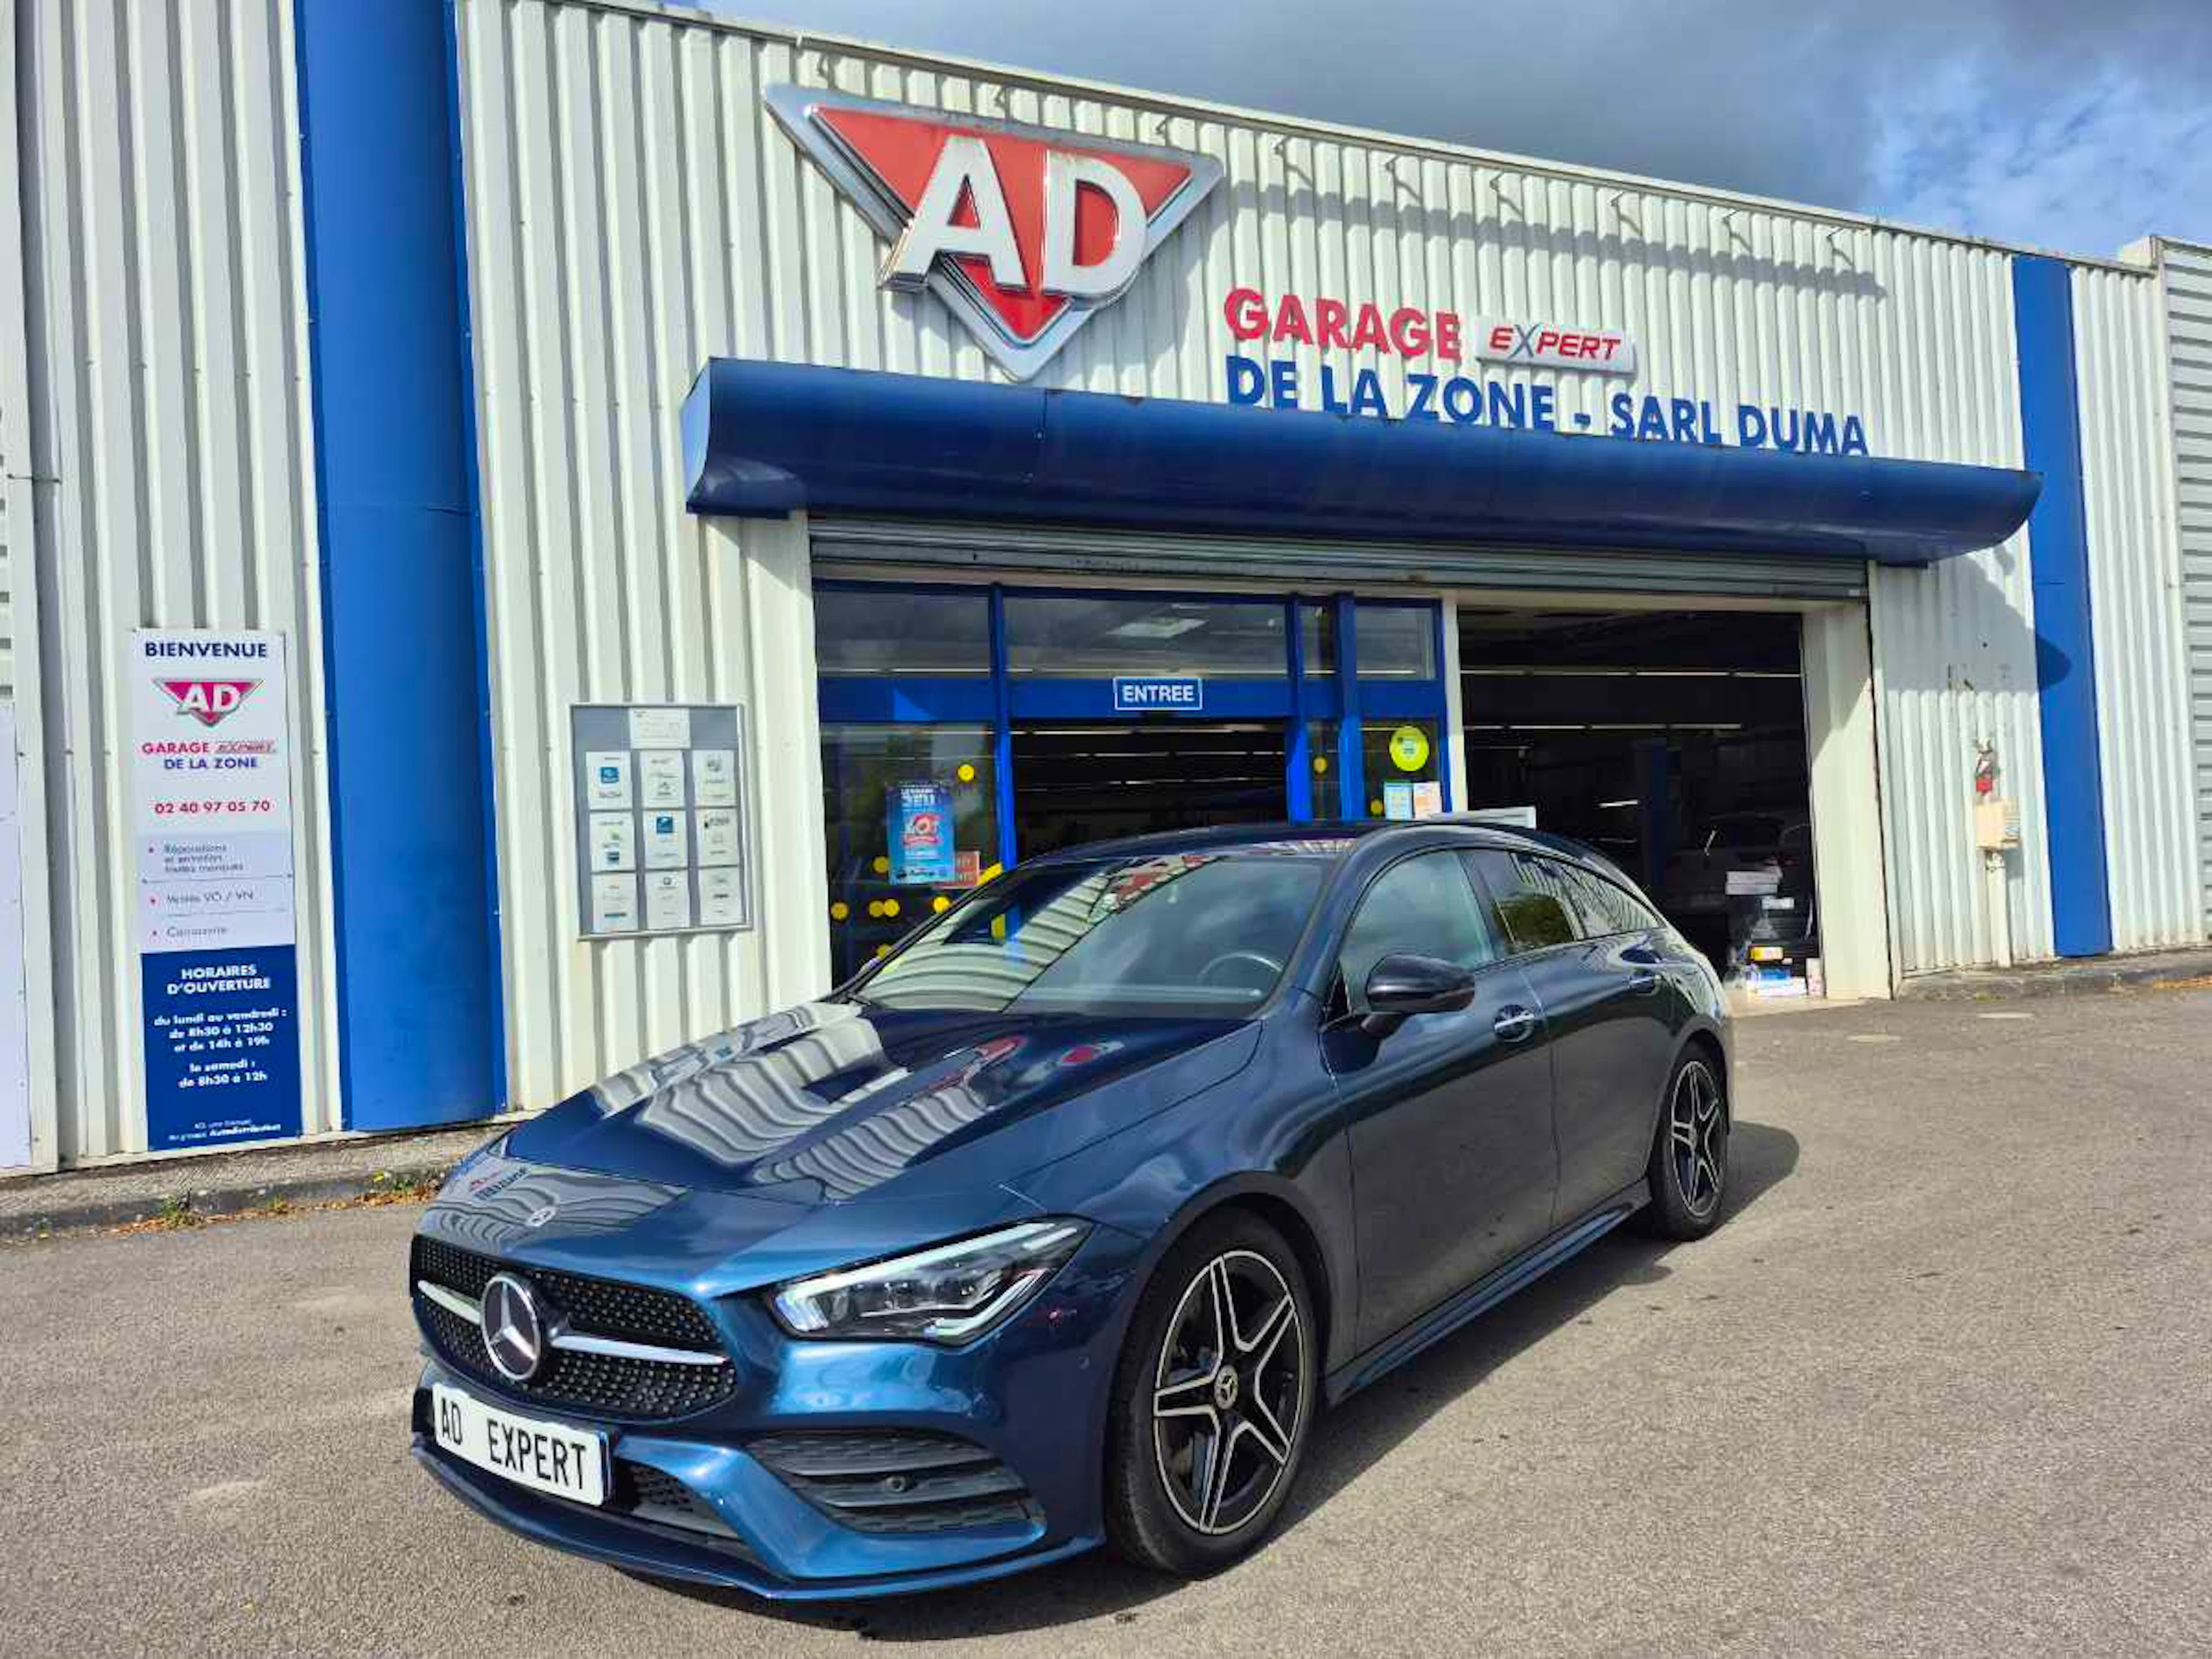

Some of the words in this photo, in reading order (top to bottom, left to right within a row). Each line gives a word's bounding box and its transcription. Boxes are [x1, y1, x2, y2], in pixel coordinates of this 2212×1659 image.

[879, 134, 1149, 298] AD
[1224, 289, 1463, 362] GARAGE
[1489, 324, 1622, 361] EXPERT
[1226, 355, 1300, 410] DE
[1322, 365, 1387, 416] LA
[1406, 374, 1555, 430] ZONE
[1574, 413, 1591, 425] -
[1611, 392, 1722, 444] SARL
[1738, 405, 1869, 456] DUMA
[145, 642, 267, 657] BIENVENUE
[177, 683, 242, 714] AD
[1123, 684, 1195, 702] ENTREE
[143, 743, 209, 754] GARAGE
[164, 759, 184, 770] DE
[190, 758, 207, 769] LA
[214, 757, 258, 769] ZONE
[154, 804, 175, 813] 02
[180, 802, 198, 813] 40
[204, 801, 222, 812] 97
[228, 801, 246, 812] 05
[251, 800, 270, 811] 70
[181, 964, 257, 979] HORAIRES
[166, 977, 271, 995] D'OUVERTURE
[174, 1013, 204, 1024] lundi
[441, 1398, 463, 1445] AD
[487, 1418, 586, 1490] EXPERT
